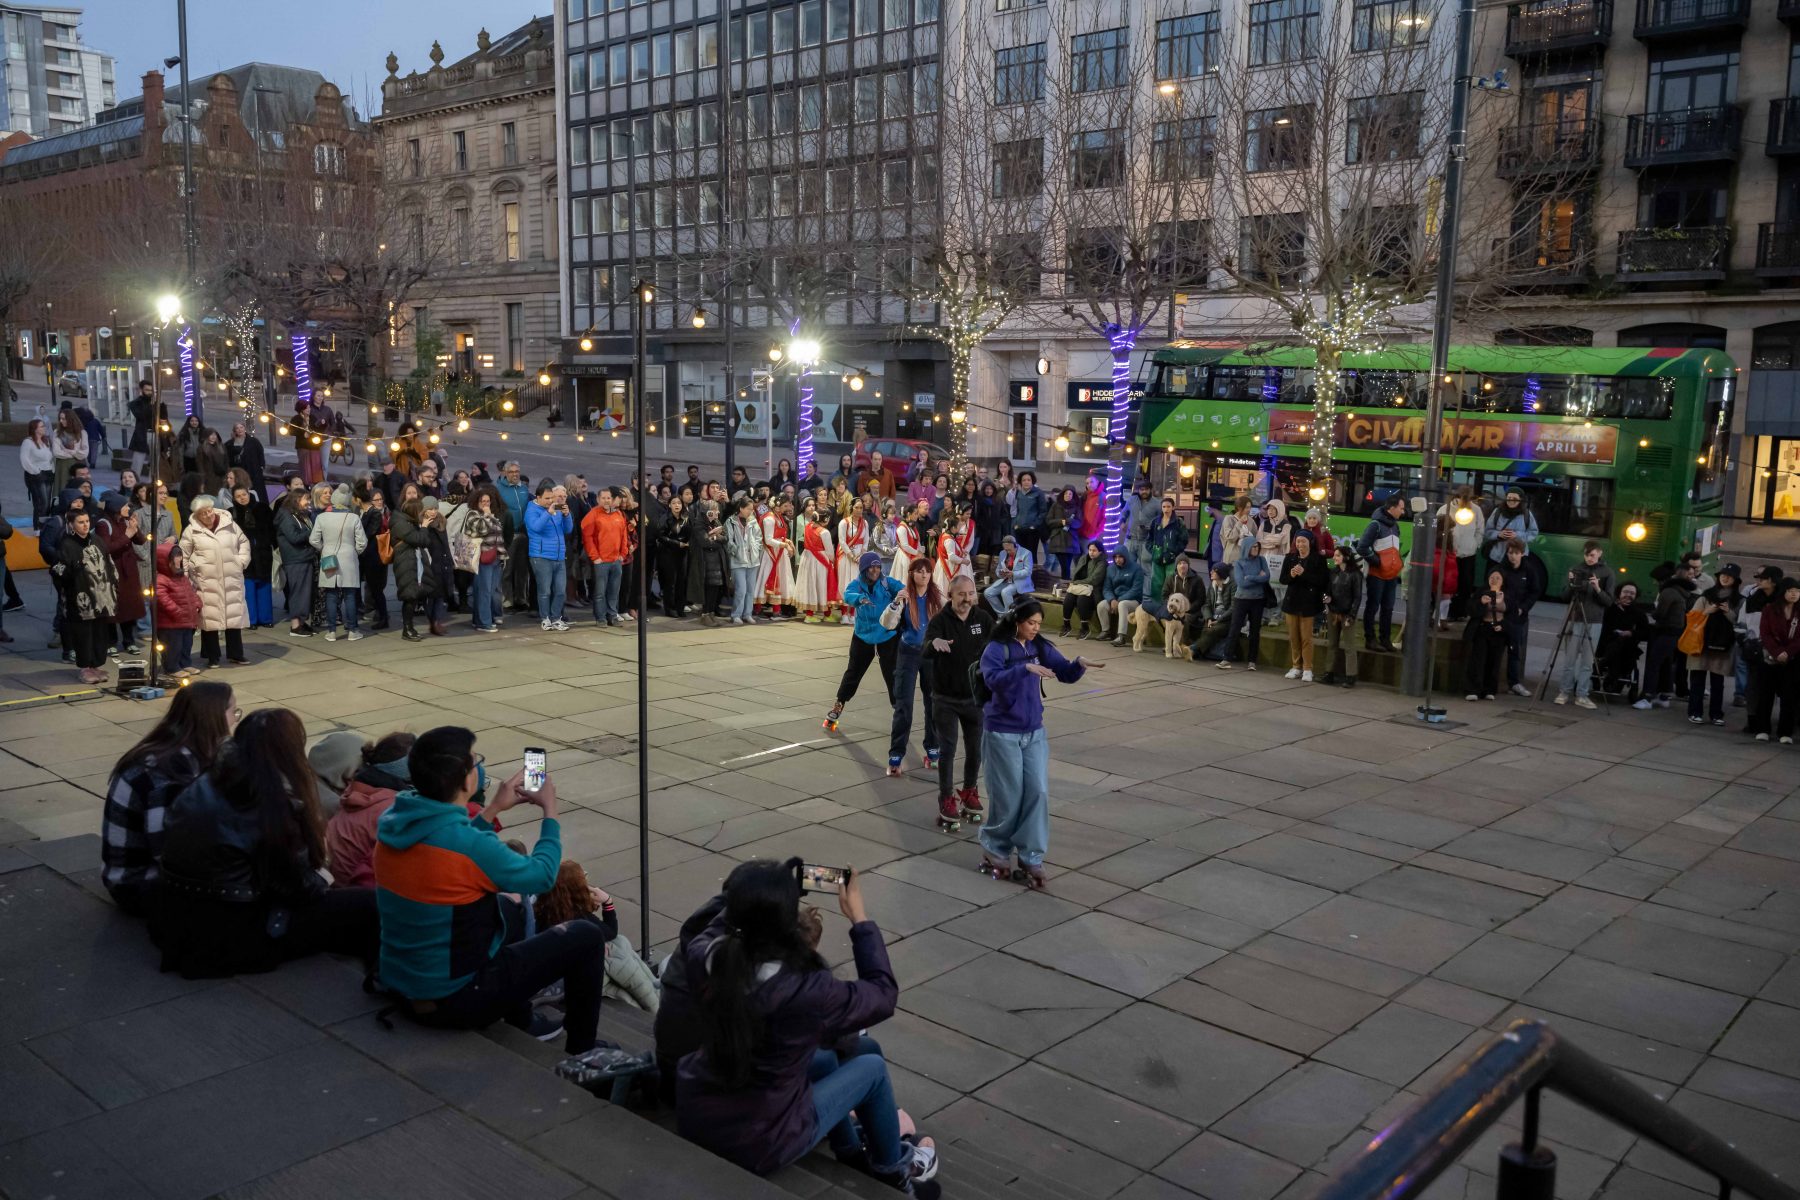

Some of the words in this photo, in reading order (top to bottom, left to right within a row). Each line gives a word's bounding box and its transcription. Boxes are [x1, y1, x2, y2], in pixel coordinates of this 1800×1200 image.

[1348, 418, 1423, 446] CIVIL
[1535, 441, 1577, 453] APRIL
[1582, 443, 1598, 455] 12
[1228, 458, 1256, 466] Middleton
